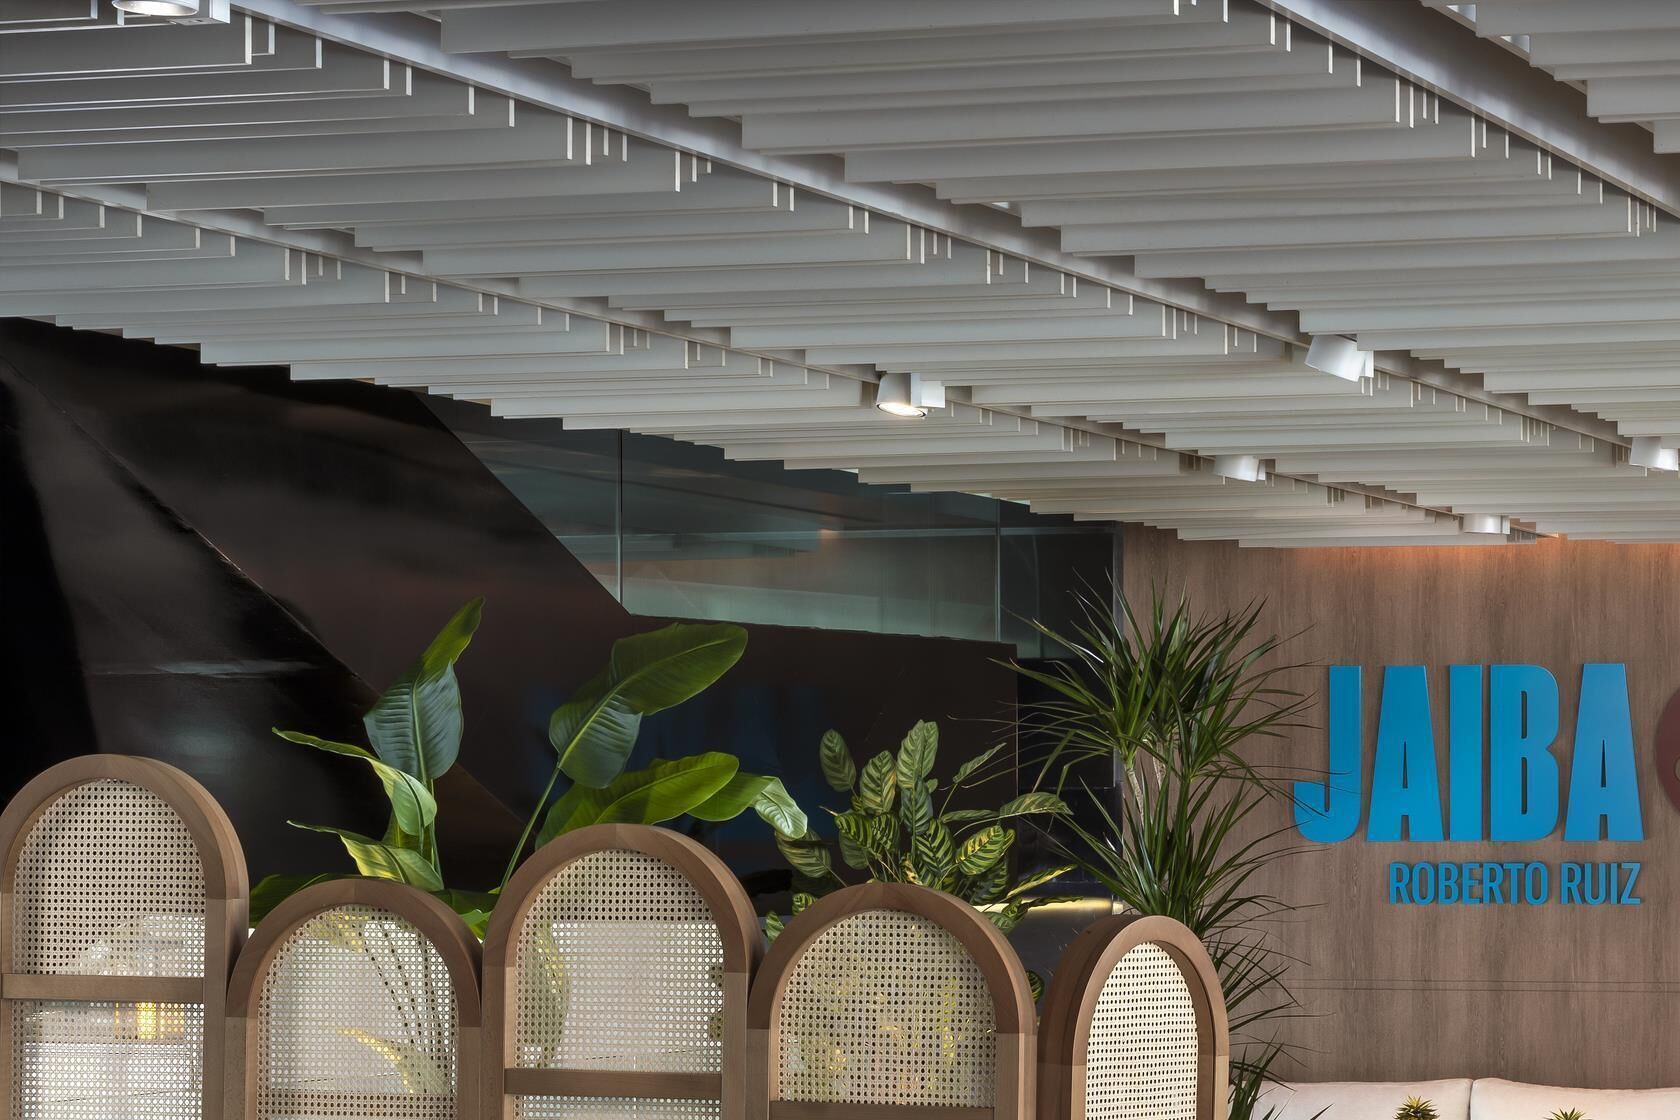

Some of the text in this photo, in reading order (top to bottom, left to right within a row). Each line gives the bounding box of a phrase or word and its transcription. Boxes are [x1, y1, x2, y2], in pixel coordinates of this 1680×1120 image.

[1293, 663, 1644, 842] JAIBA
[1389, 861, 1641, 905] ROBERTO RUIZ
